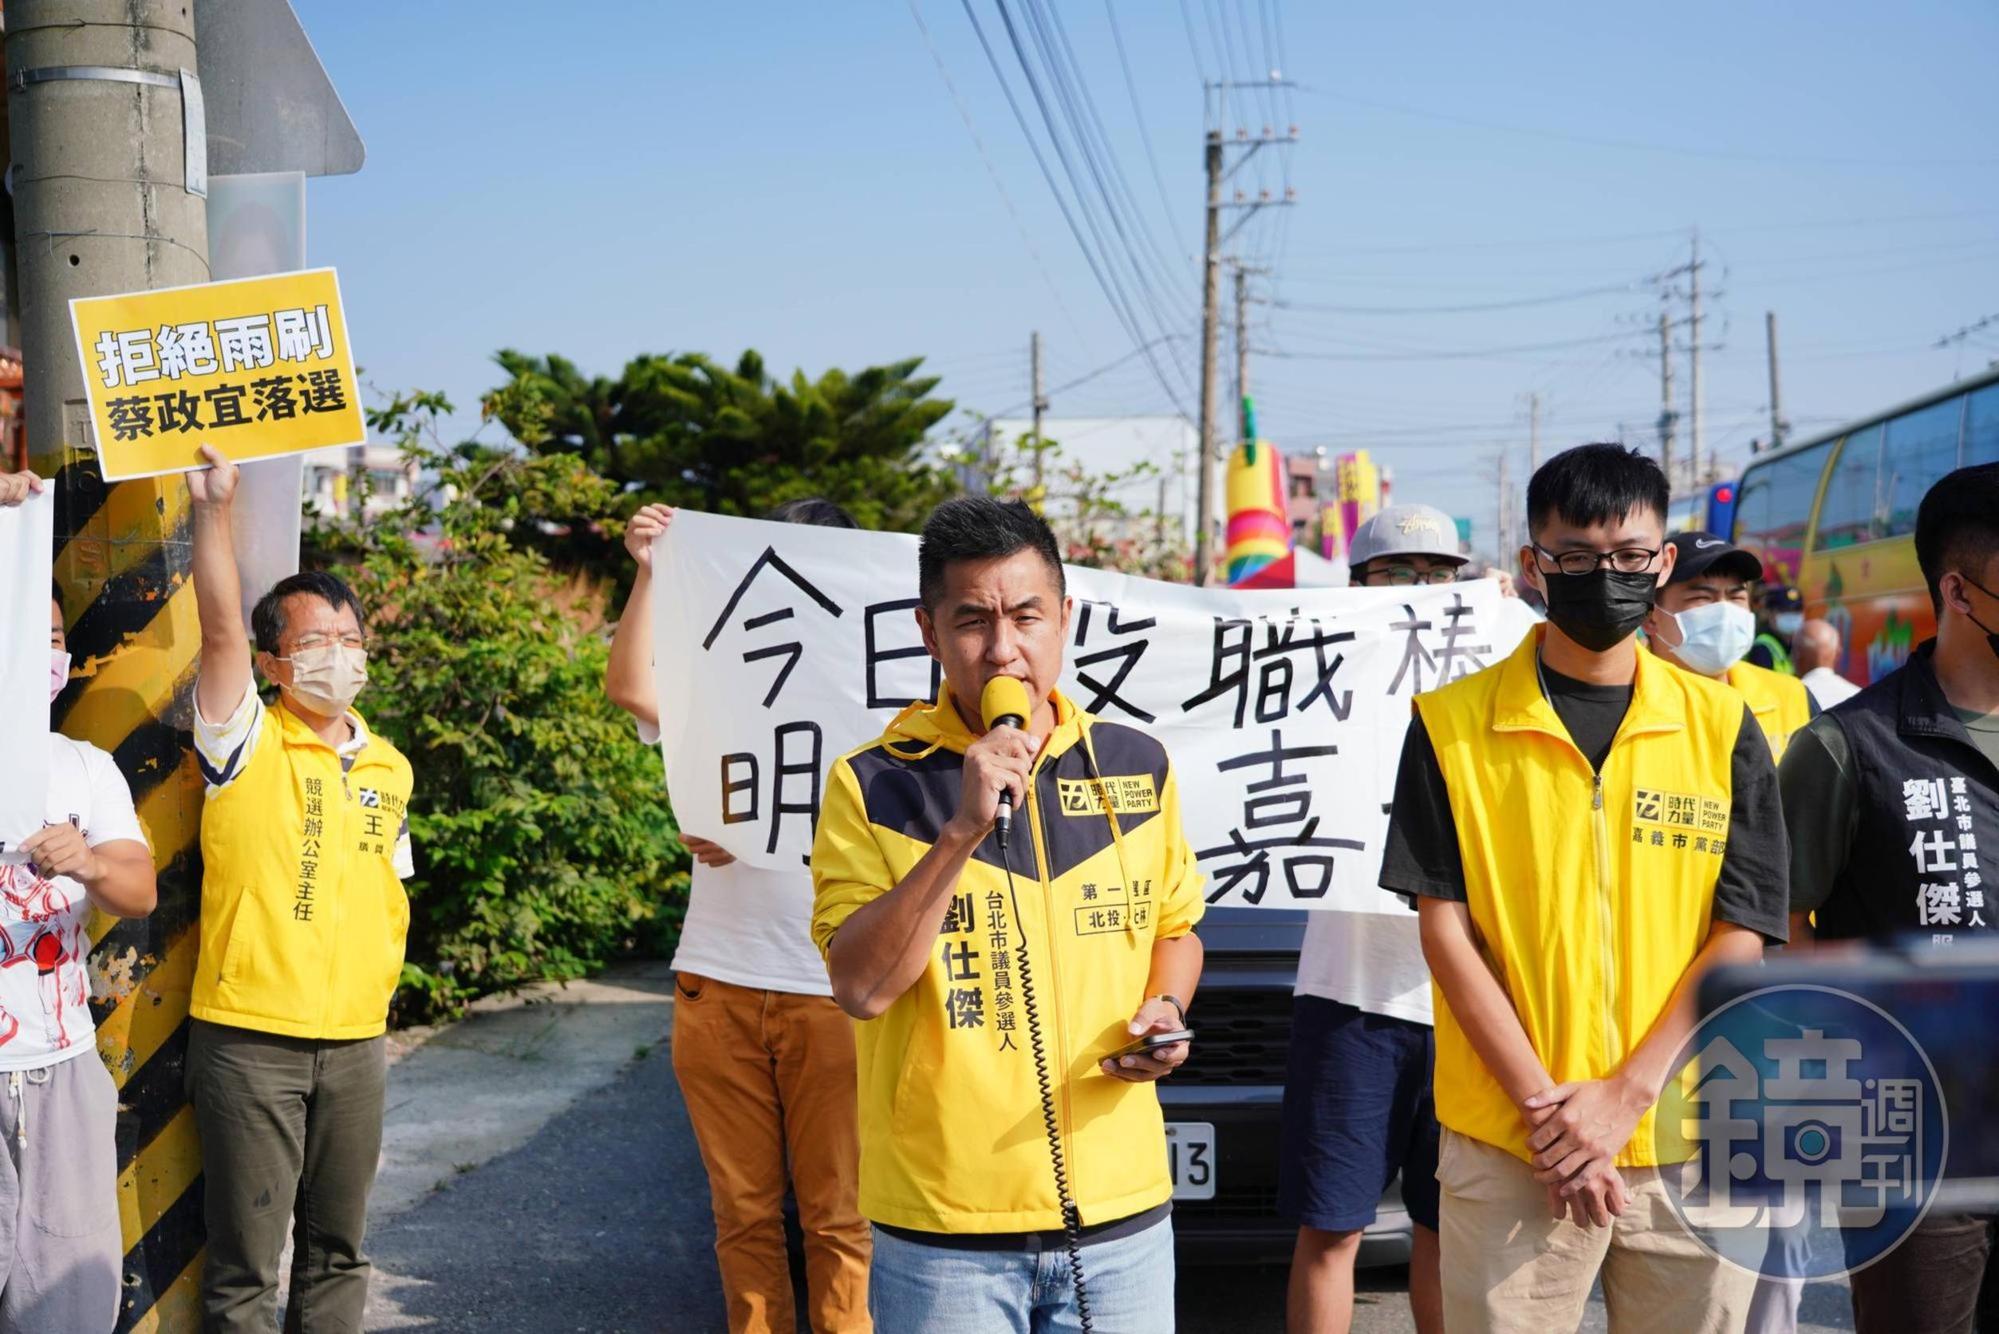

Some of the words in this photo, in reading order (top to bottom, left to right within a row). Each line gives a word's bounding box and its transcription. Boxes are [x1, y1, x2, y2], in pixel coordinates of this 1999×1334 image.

[95, 304, 335, 388] 拒絕雨刷
[106, 368, 347, 442] 蔡政宜落選
[1123, 781, 1140, 789] NEW
[1125, 789, 1153, 799] POWER
[1127, 799, 1152, 808] PARTY
[1668, 796, 1696, 811] 時代
[1704, 800, 1720, 810] NEW
[1668, 811, 1695, 825] 力量
[1703, 810, 1727, 820] POWER
[1702, 819, 1724, 831] PARTY
[1633, 827, 1726, 855] 嘉義市黨部
[293, 777, 322, 921] 競選辦公室主任
[1902, 777, 1962, 926] 劉仕傑
[939, 893, 985, 1029] 劉仕傑
[985, 890, 1018, 1052] 台北市議員參選人
